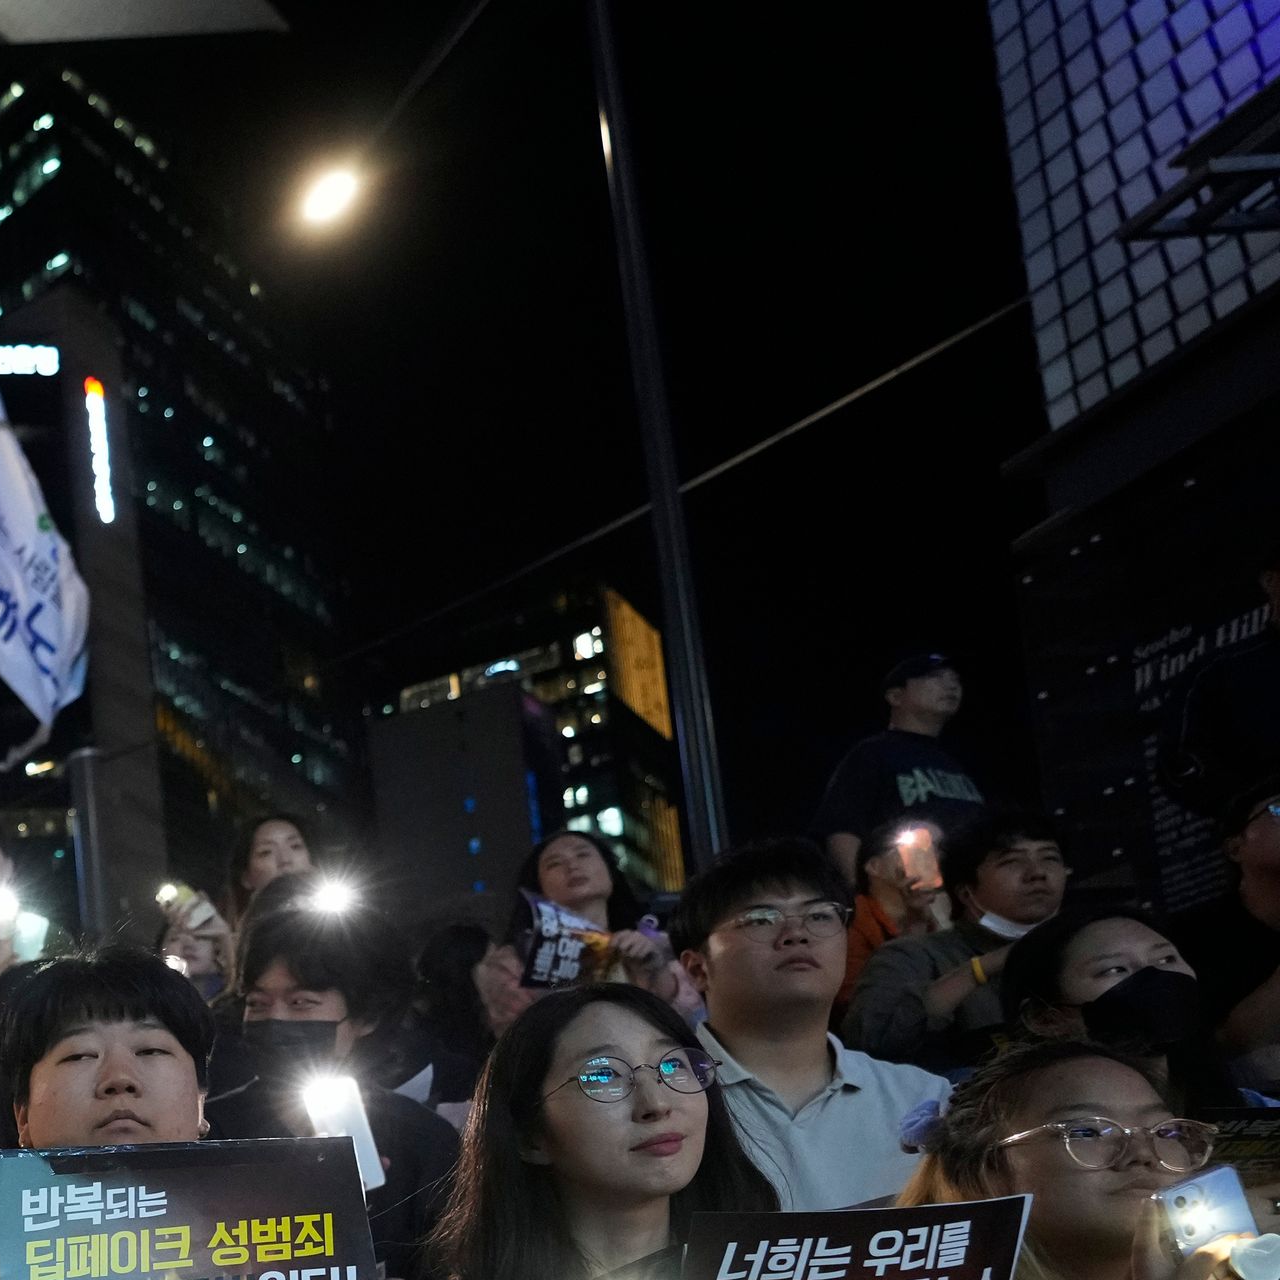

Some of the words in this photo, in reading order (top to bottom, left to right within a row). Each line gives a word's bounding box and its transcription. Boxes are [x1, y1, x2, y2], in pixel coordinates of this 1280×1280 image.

[21, 1181, 167, 1232] 반복되는
[207, 1212, 334, 1267] 성범죄
[863, 1220, 972, 1277] 우리를
